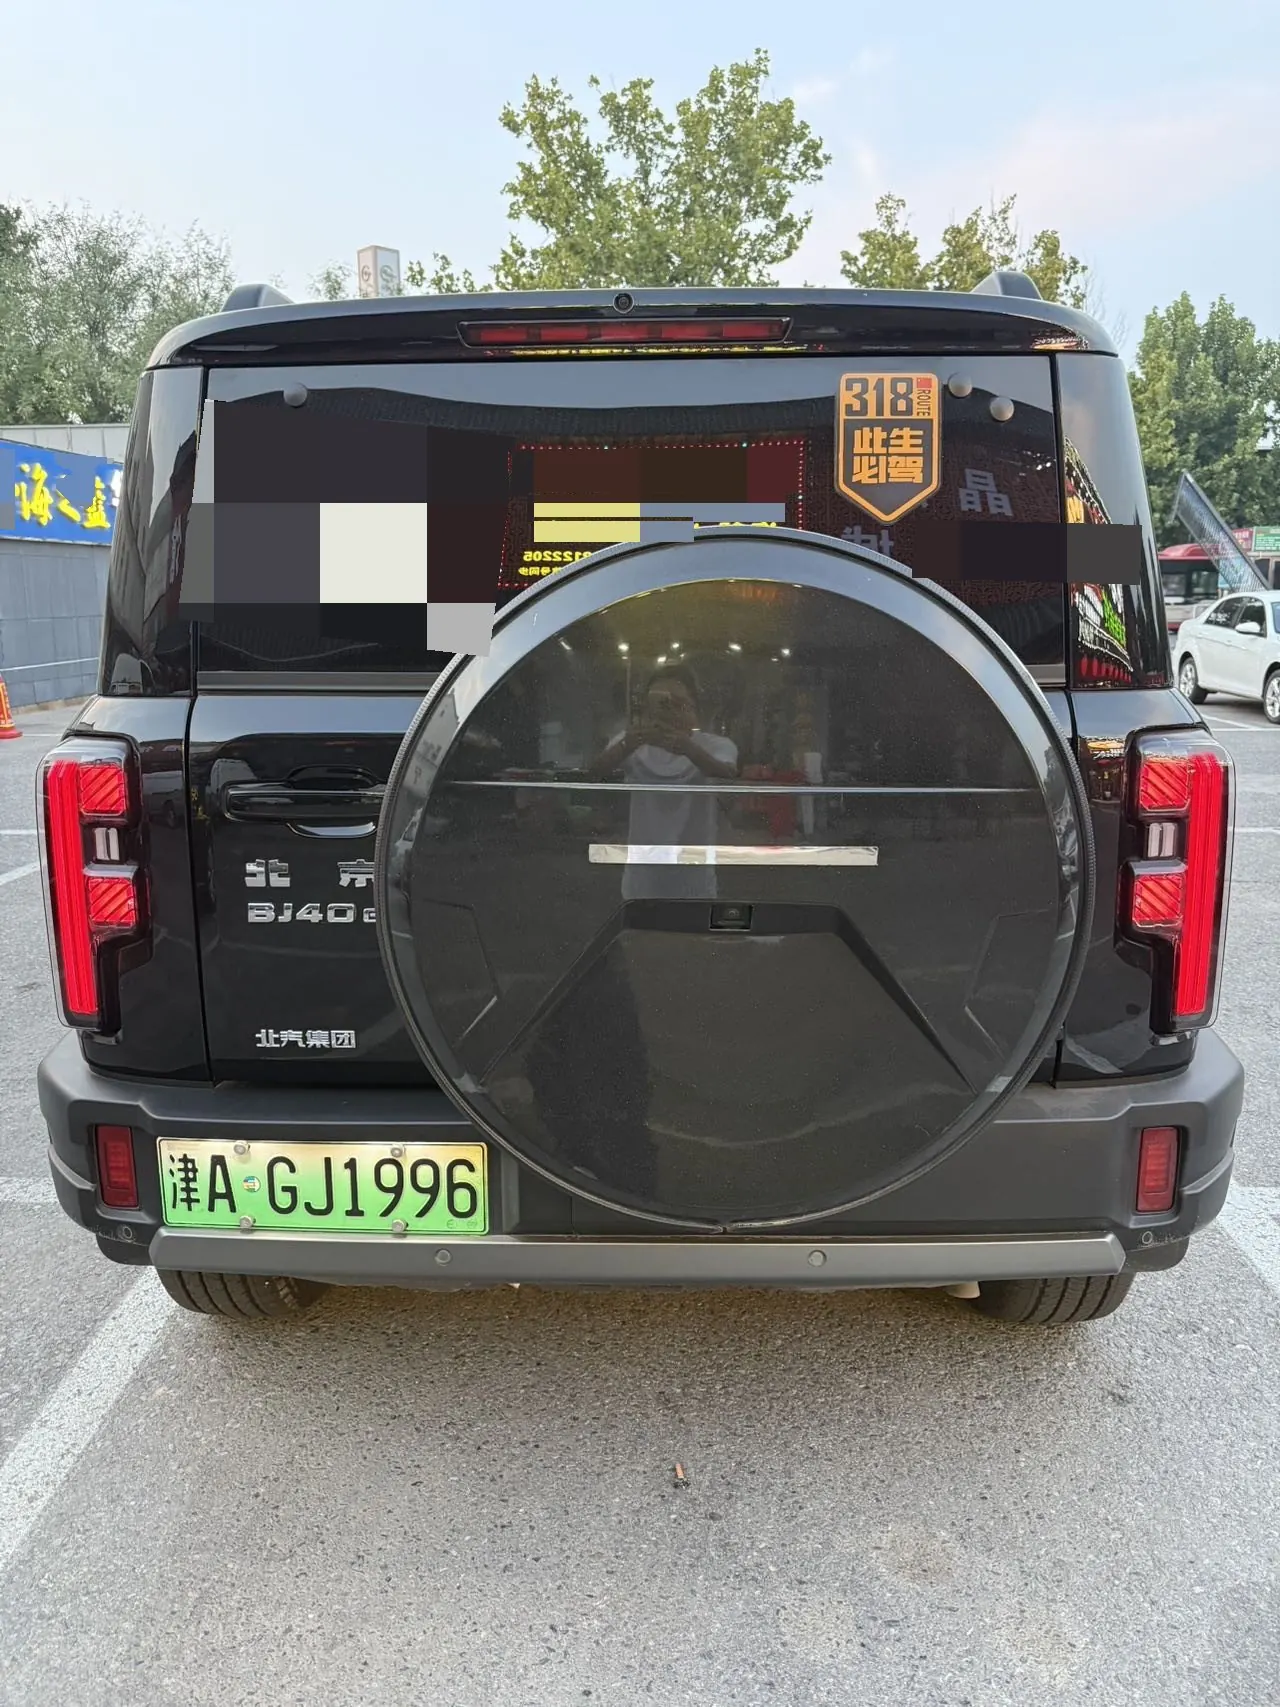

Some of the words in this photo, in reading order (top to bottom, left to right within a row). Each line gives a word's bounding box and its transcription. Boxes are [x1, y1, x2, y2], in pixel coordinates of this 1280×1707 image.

[844, 377, 914, 417] 318
[915, 389, 932, 417] ROUTE
[853, 427, 924, 454] 此生
[852, 455, 924, 485] 必驾
[255, 1028, 357, 1049] 北汽集团
[168, 1153, 237, 1213] 津A
[267, 1156, 478, 1218] GJ1996
